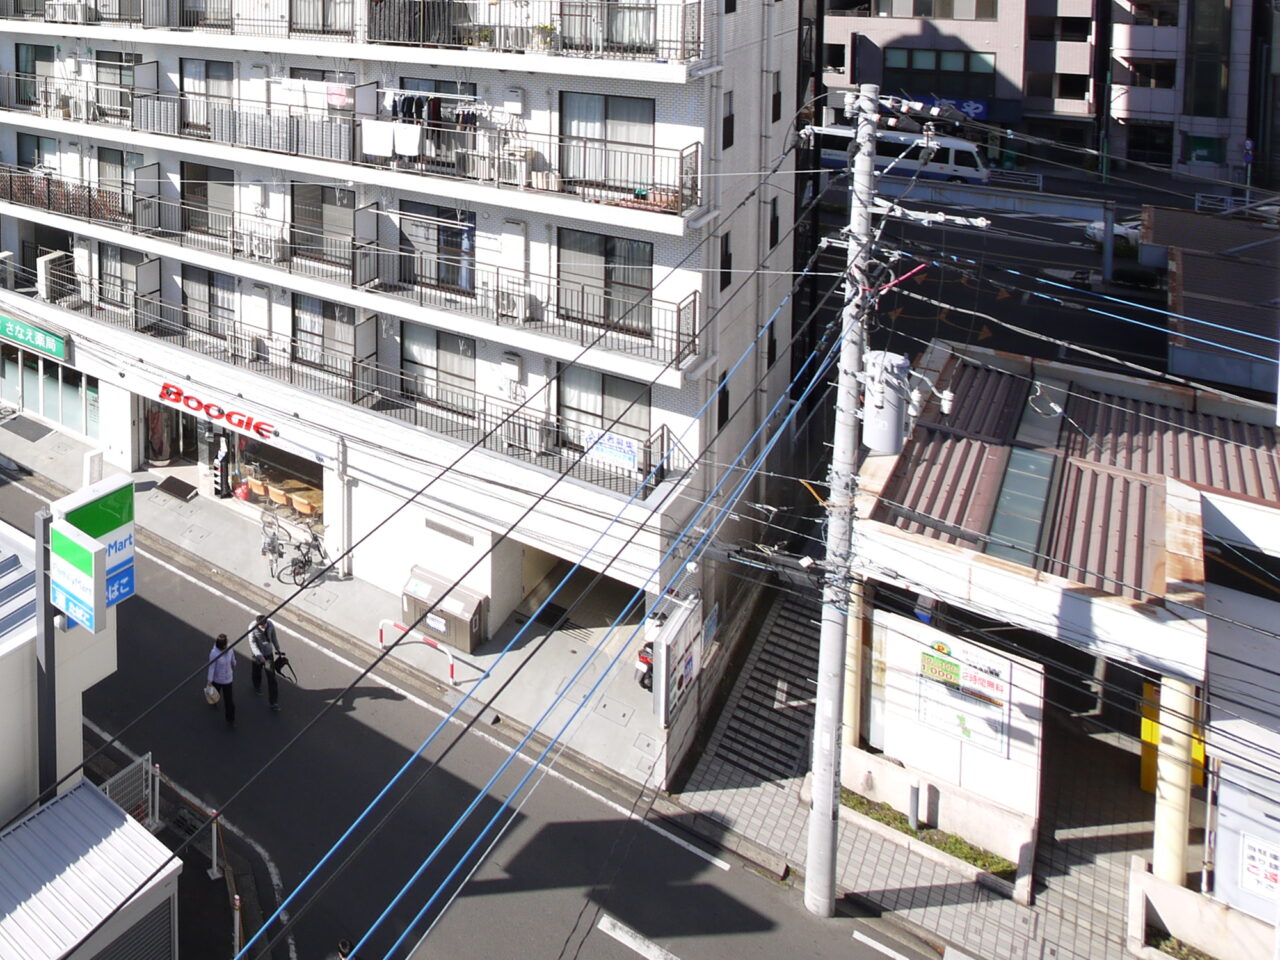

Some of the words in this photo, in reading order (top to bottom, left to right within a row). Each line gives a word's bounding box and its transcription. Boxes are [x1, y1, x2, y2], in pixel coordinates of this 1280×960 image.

[5, 321, 57, 353] さなえ薬局
[158, 382, 276, 439] BOOGIE
